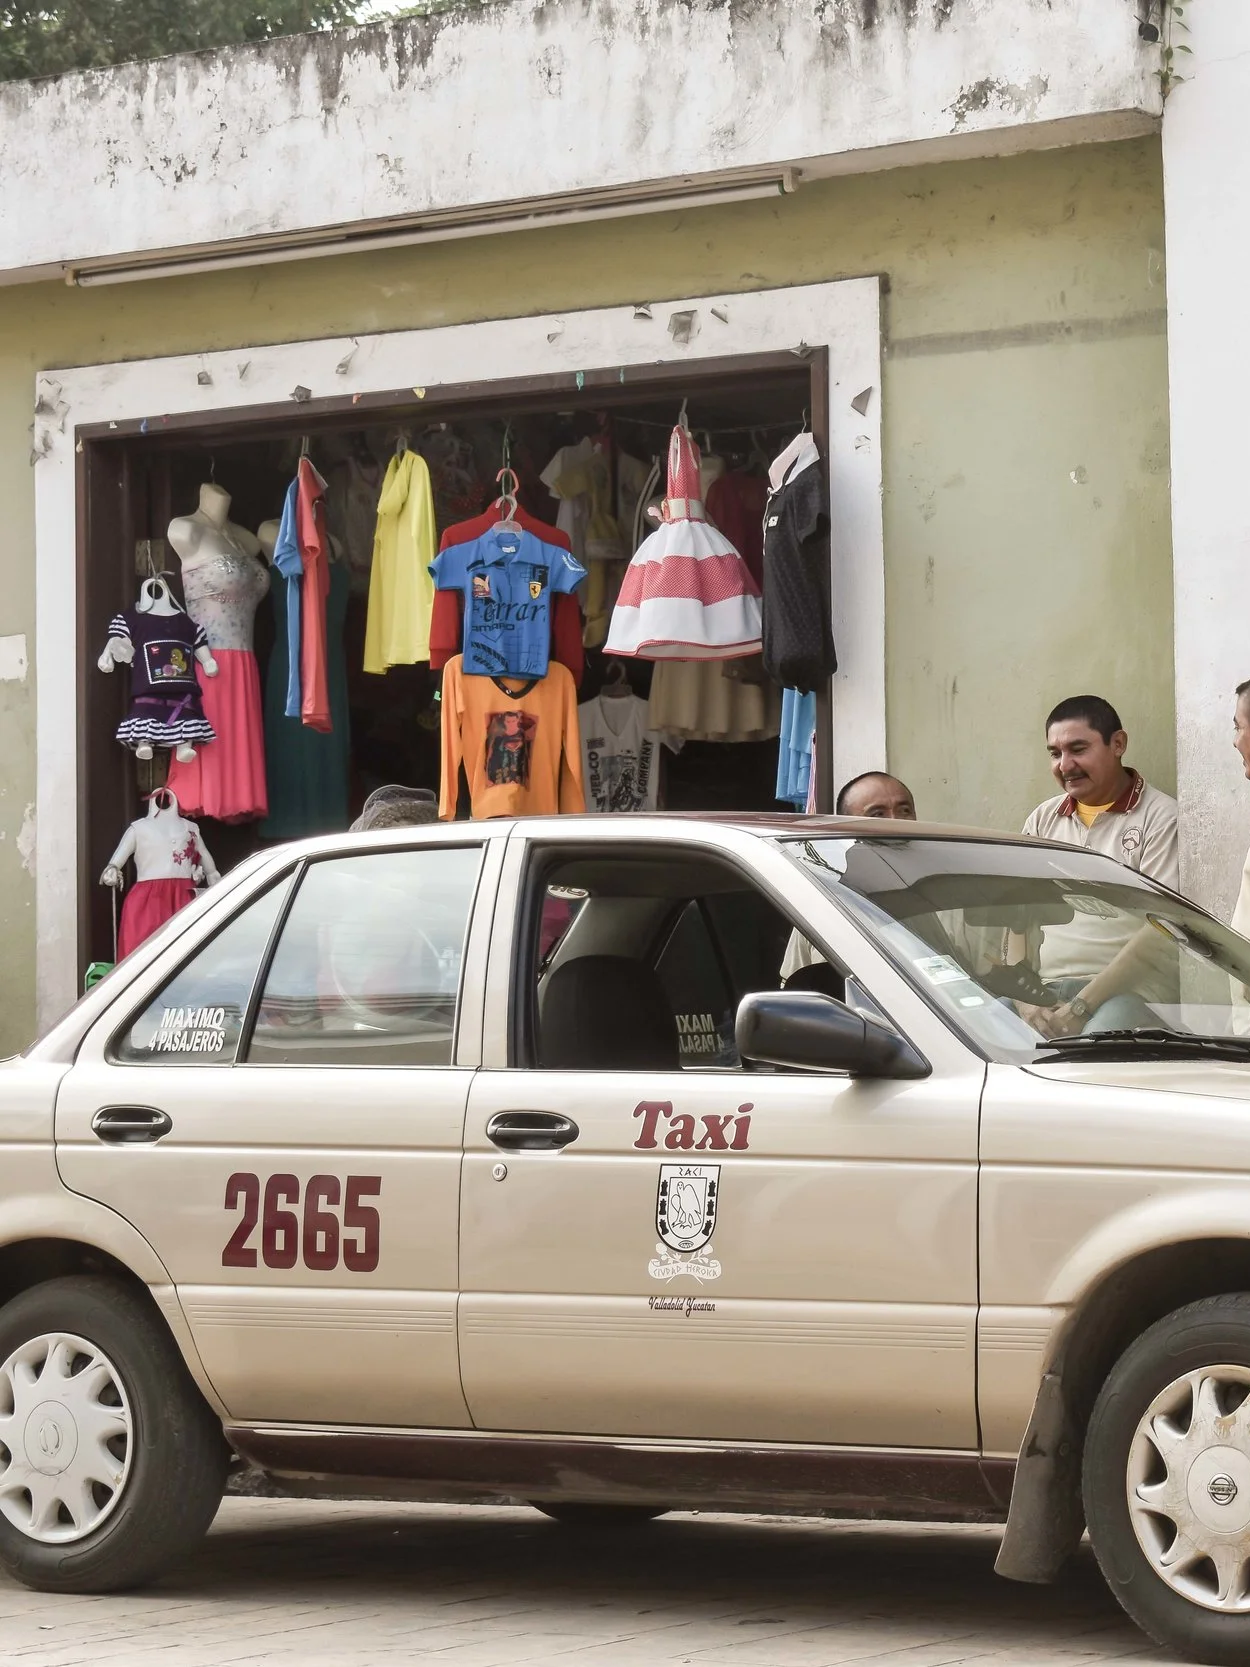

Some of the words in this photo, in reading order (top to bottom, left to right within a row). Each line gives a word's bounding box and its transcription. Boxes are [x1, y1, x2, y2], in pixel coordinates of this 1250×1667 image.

[157, 1030, 226, 1052] PASAJEROS
[631, 1099, 756, 1151] Taxi
[221, 1172, 382, 1273] 2665
[648, 1296, 684, 1312] Valladolid
[686, 1296, 716, 1318] Yucatan
